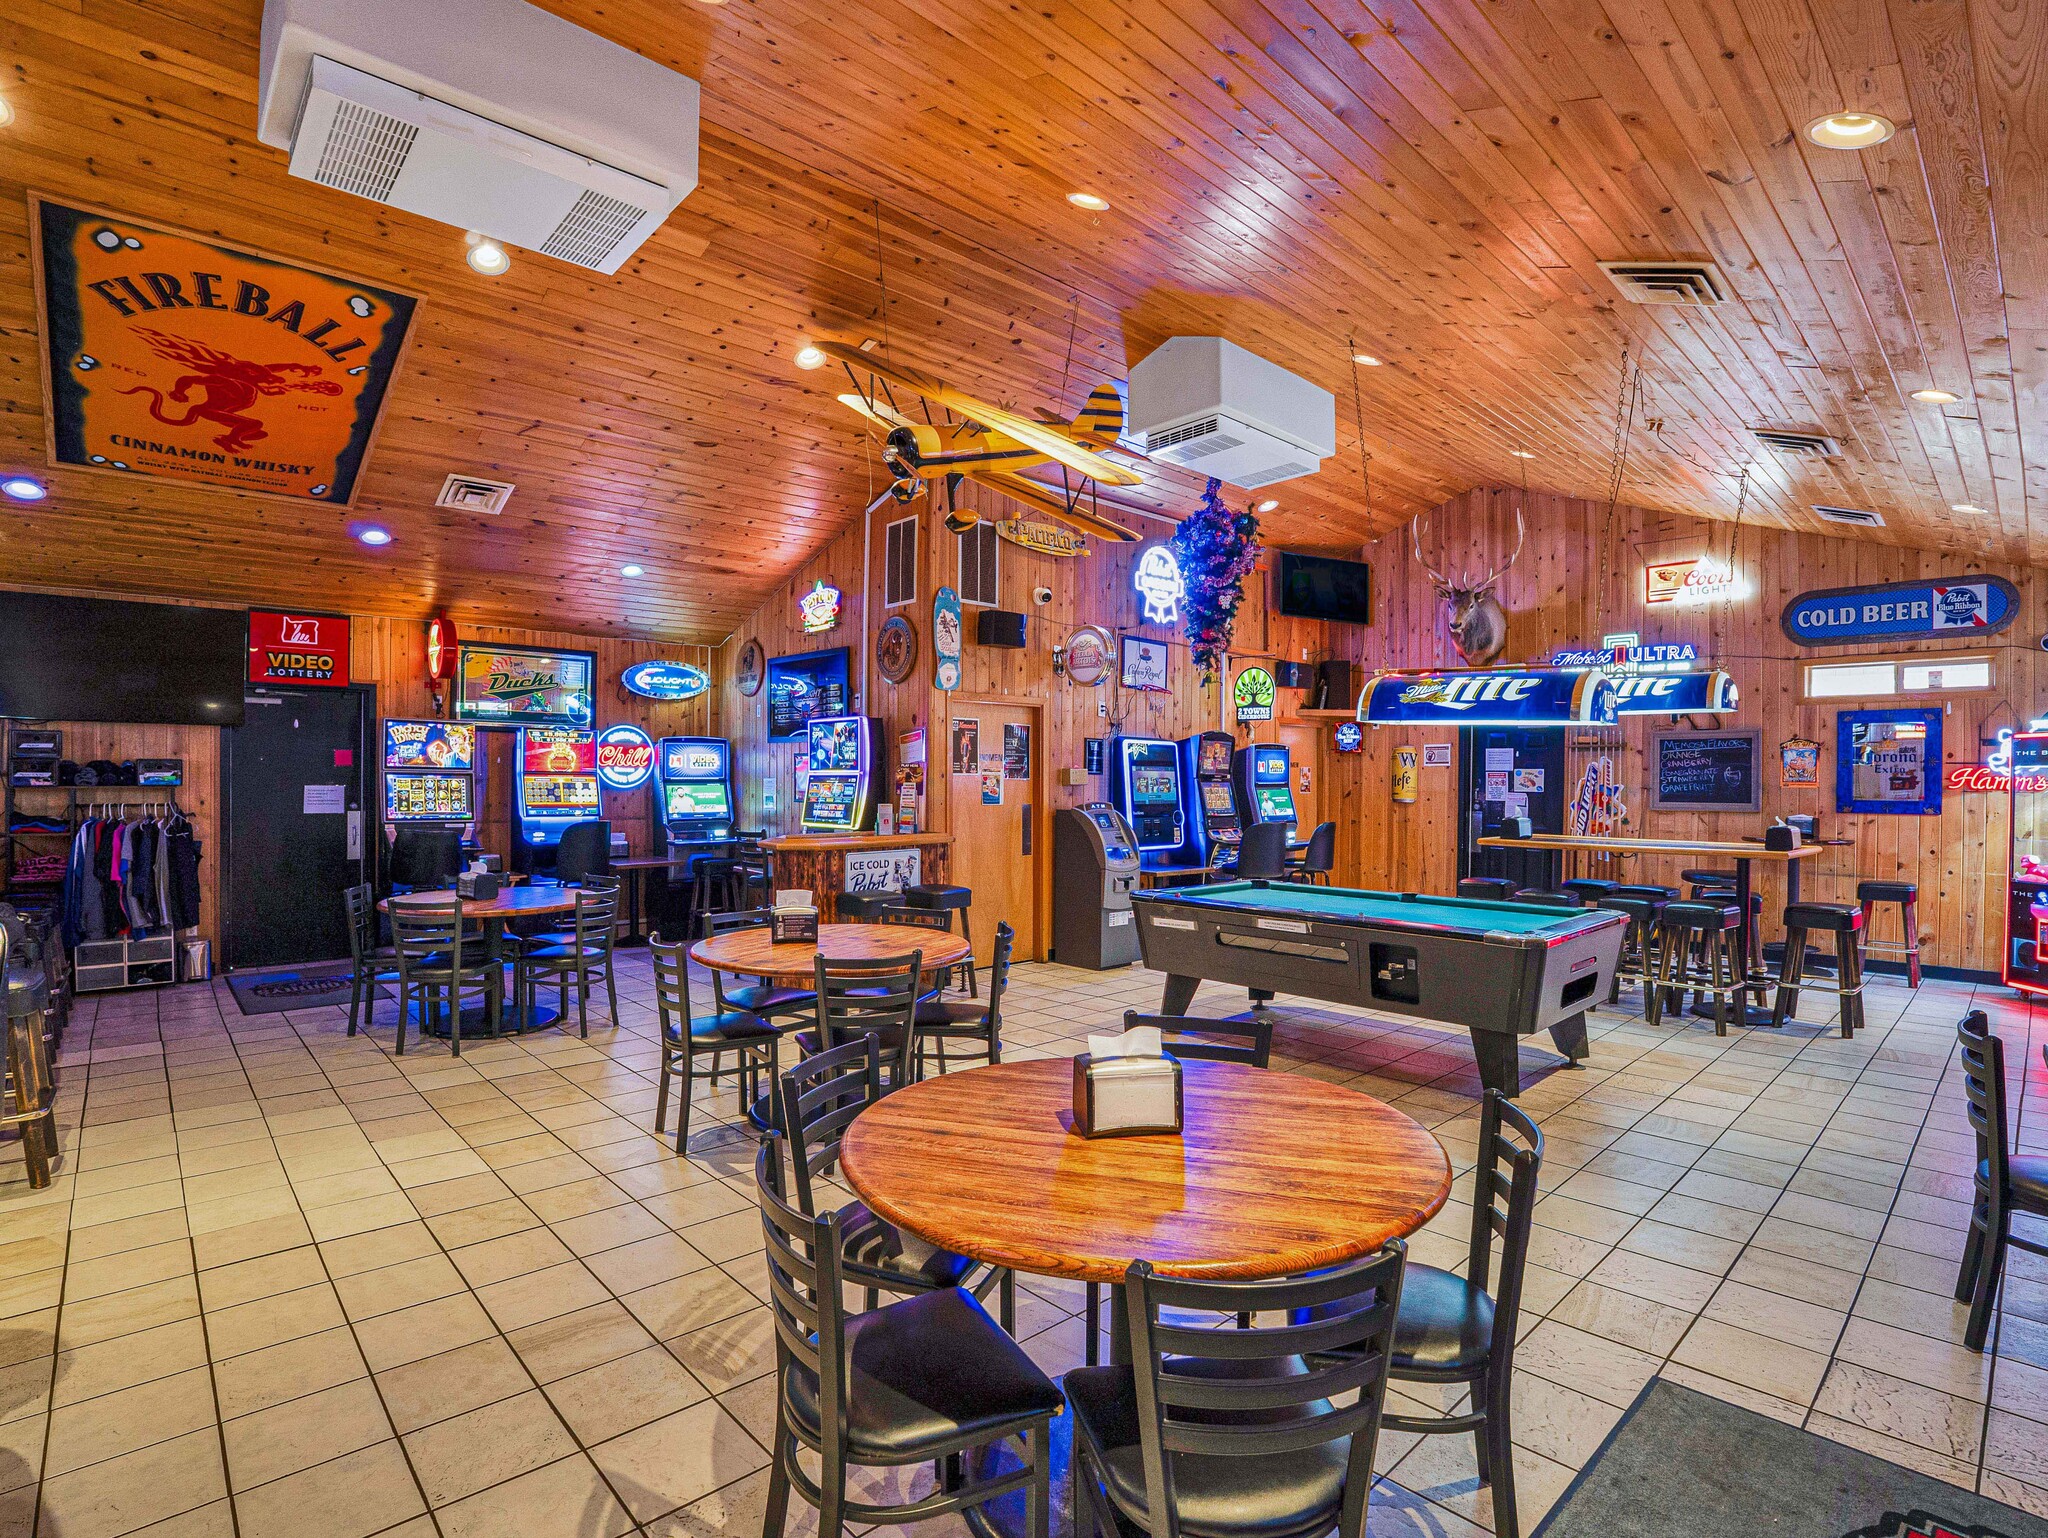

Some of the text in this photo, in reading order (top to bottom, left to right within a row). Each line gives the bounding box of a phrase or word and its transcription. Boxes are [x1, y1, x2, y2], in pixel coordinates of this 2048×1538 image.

[87, 271, 367, 363] FIREBALL
[111, 363, 147, 377] RED
[297, 404, 329, 413] HOT
[110, 434, 226, 464] CINNAMON
[233, 457, 315, 476] WHISKY
[1689, 584, 1727, 596] LIGHT
[1946, 592, 1971, 603] Pabst
[1938, 603, 1955, 611] Blue
[1954, 601, 1981, 610] Ribbon
[1797, 601, 1929, 628] COLD BEER
[1628, 644, 1696, 661] ULTRA
[268, 652, 334, 670] VIDEO
[268, 667, 333, 679] LOTTERY
[1142, 665, 1164, 681] Royal
[487, 671, 559, 692] Ducks
[1432, 676, 1543, 710] Lite
[1238, 707, 1271, 715] 2 TOWNS
[599, 745, 651, 767] Chill
[1396, 752, 1418, 768] W
[1661, 750, 1702, 760] ORANGE
[1873, 752, 1917, 763] orona
[1661, 757, 1712, 769] CRANBERRY
[1581, 765, 1598, 811] LIGHT
[850, 859, 890, 871] ICE COLD
[850, 869, 889, 891] Pabst
[2012, 890, 2033, 898] THE
